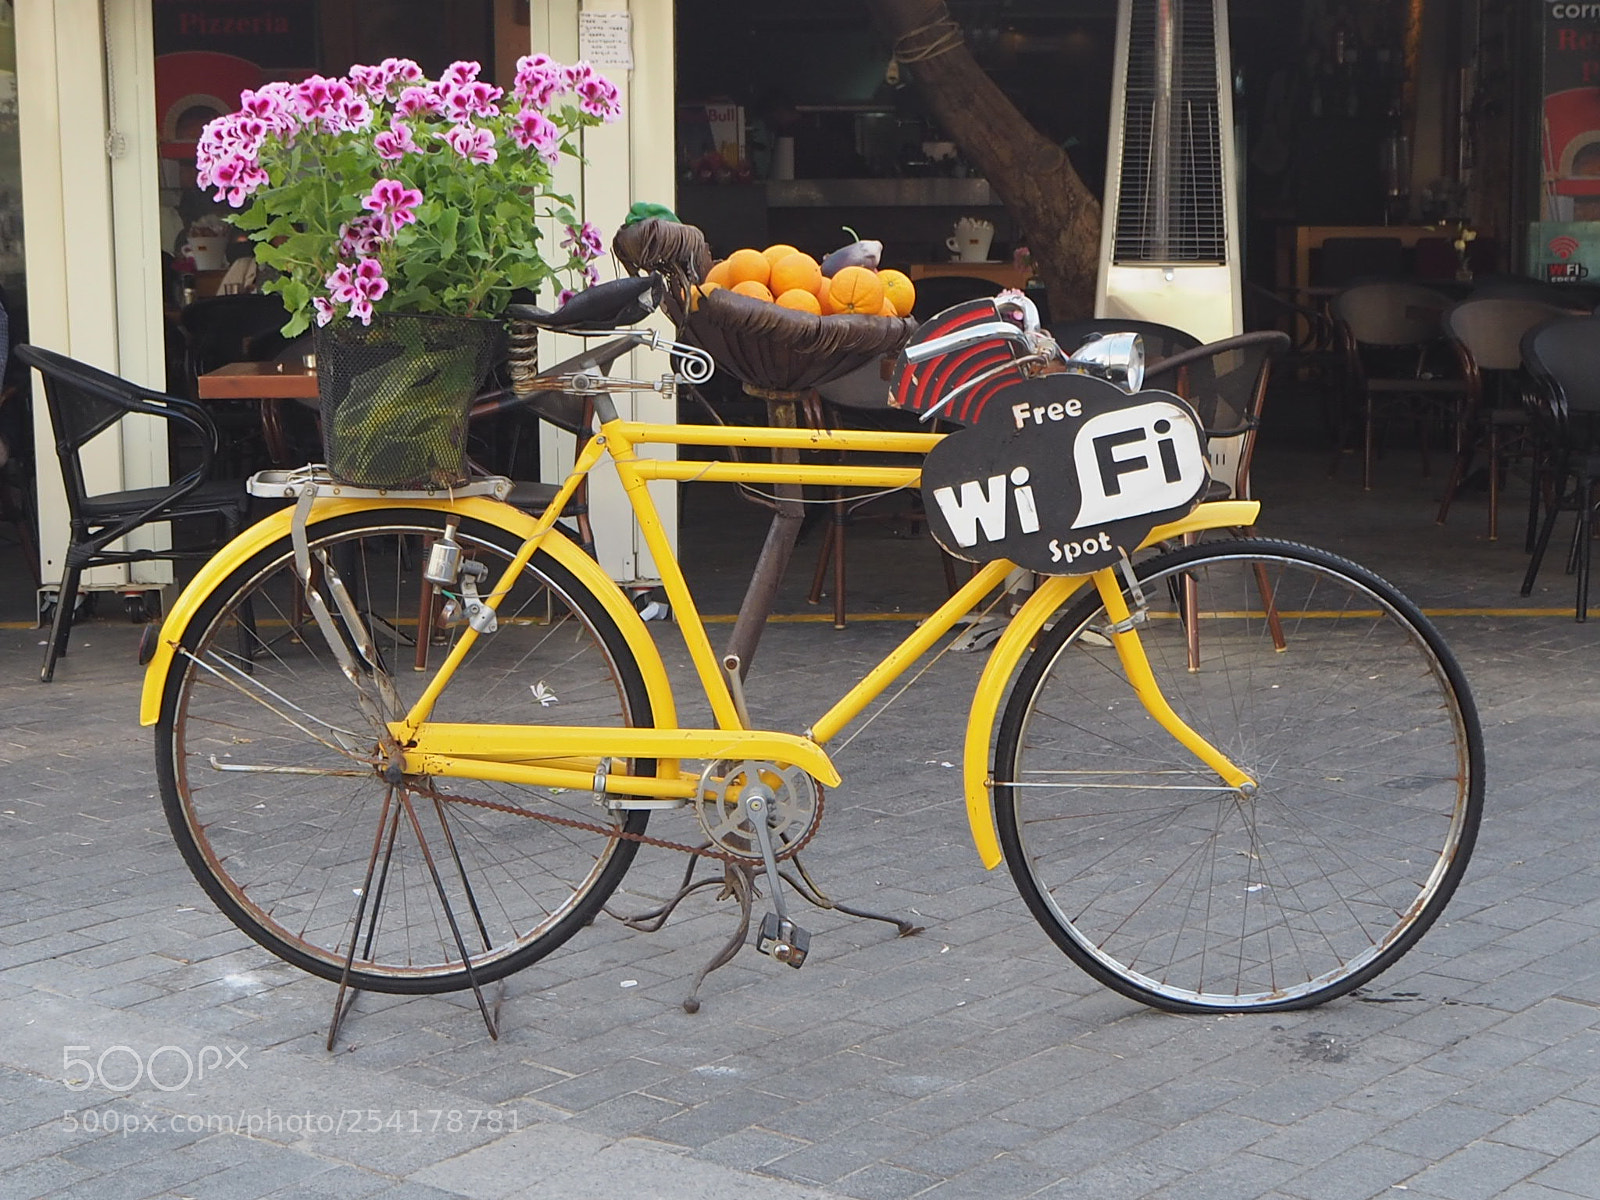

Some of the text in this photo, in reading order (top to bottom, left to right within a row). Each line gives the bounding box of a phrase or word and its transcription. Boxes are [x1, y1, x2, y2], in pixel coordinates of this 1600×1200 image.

[178, 12, 289, 34] Pizzeria
[708, 108, 735, 122] Bull
[1011, 398, 1082, 430] Free
[933, 419, 1182, 548] Wi Fi
[1049, 532, 1113, 564] Spot
